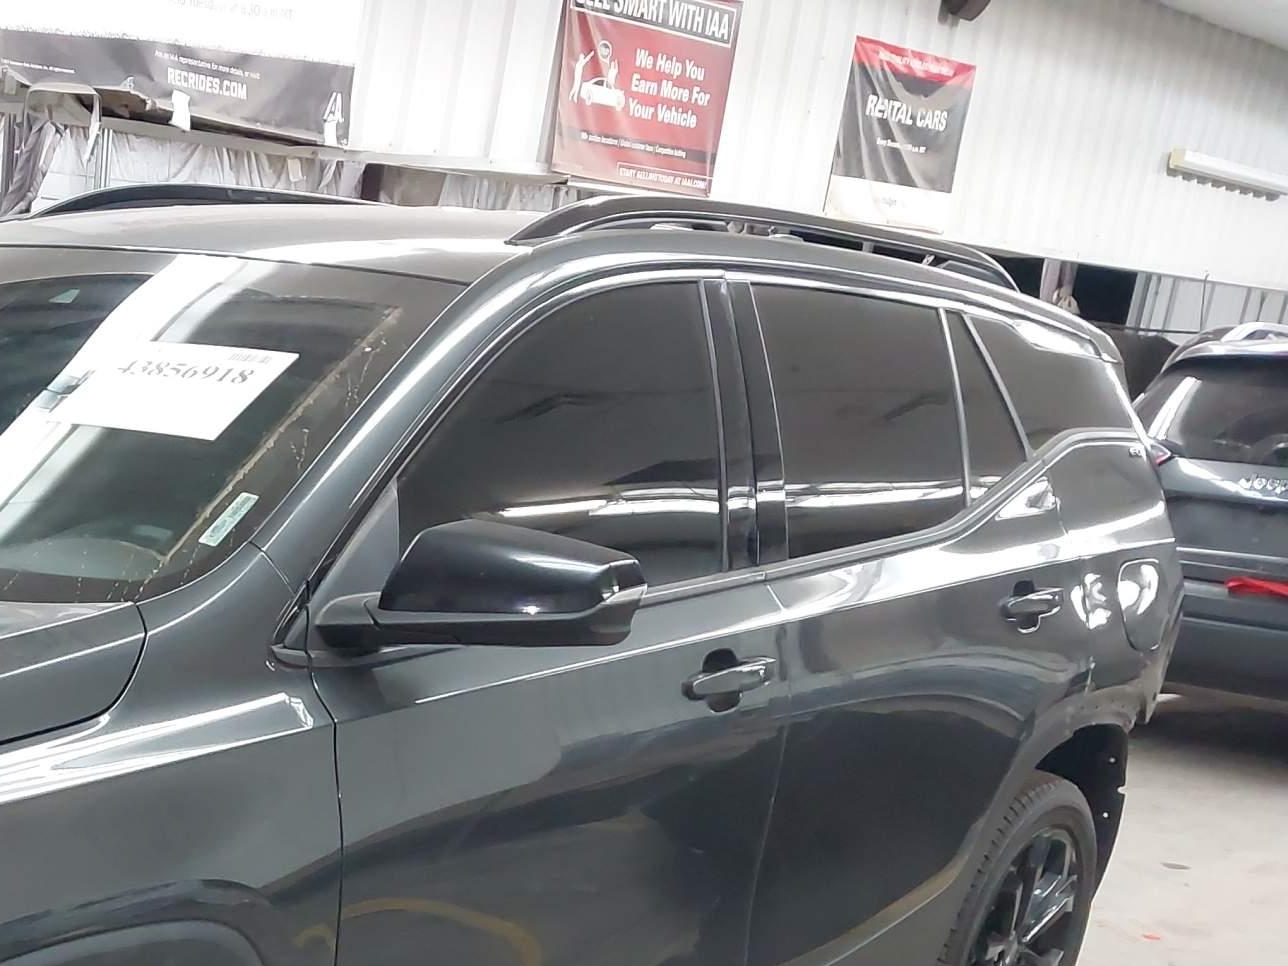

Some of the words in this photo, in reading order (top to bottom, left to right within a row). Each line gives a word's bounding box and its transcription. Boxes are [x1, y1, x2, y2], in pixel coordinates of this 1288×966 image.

[668, 1, 704, 34] WITH
[706, 9, 729, 40] IAA
[635, 48, 653, 69] We
[656, 53, 683, 79] Help
[685, 60, 705, 81] You
[167, 66, 247, 100] RECRIDES.COM
[631, 74, 658, 96] Earn
[660, 80, 690, 104] More
[691, 86, 710, 106] For
[628, 98, 654, 120] Your
[657, 103, 697, 128] Vehicle
[865, 93, 914, 126] RENTAL
[916, 108, 948, 131] CARS
[117, 360, 255, 384] 43856918
